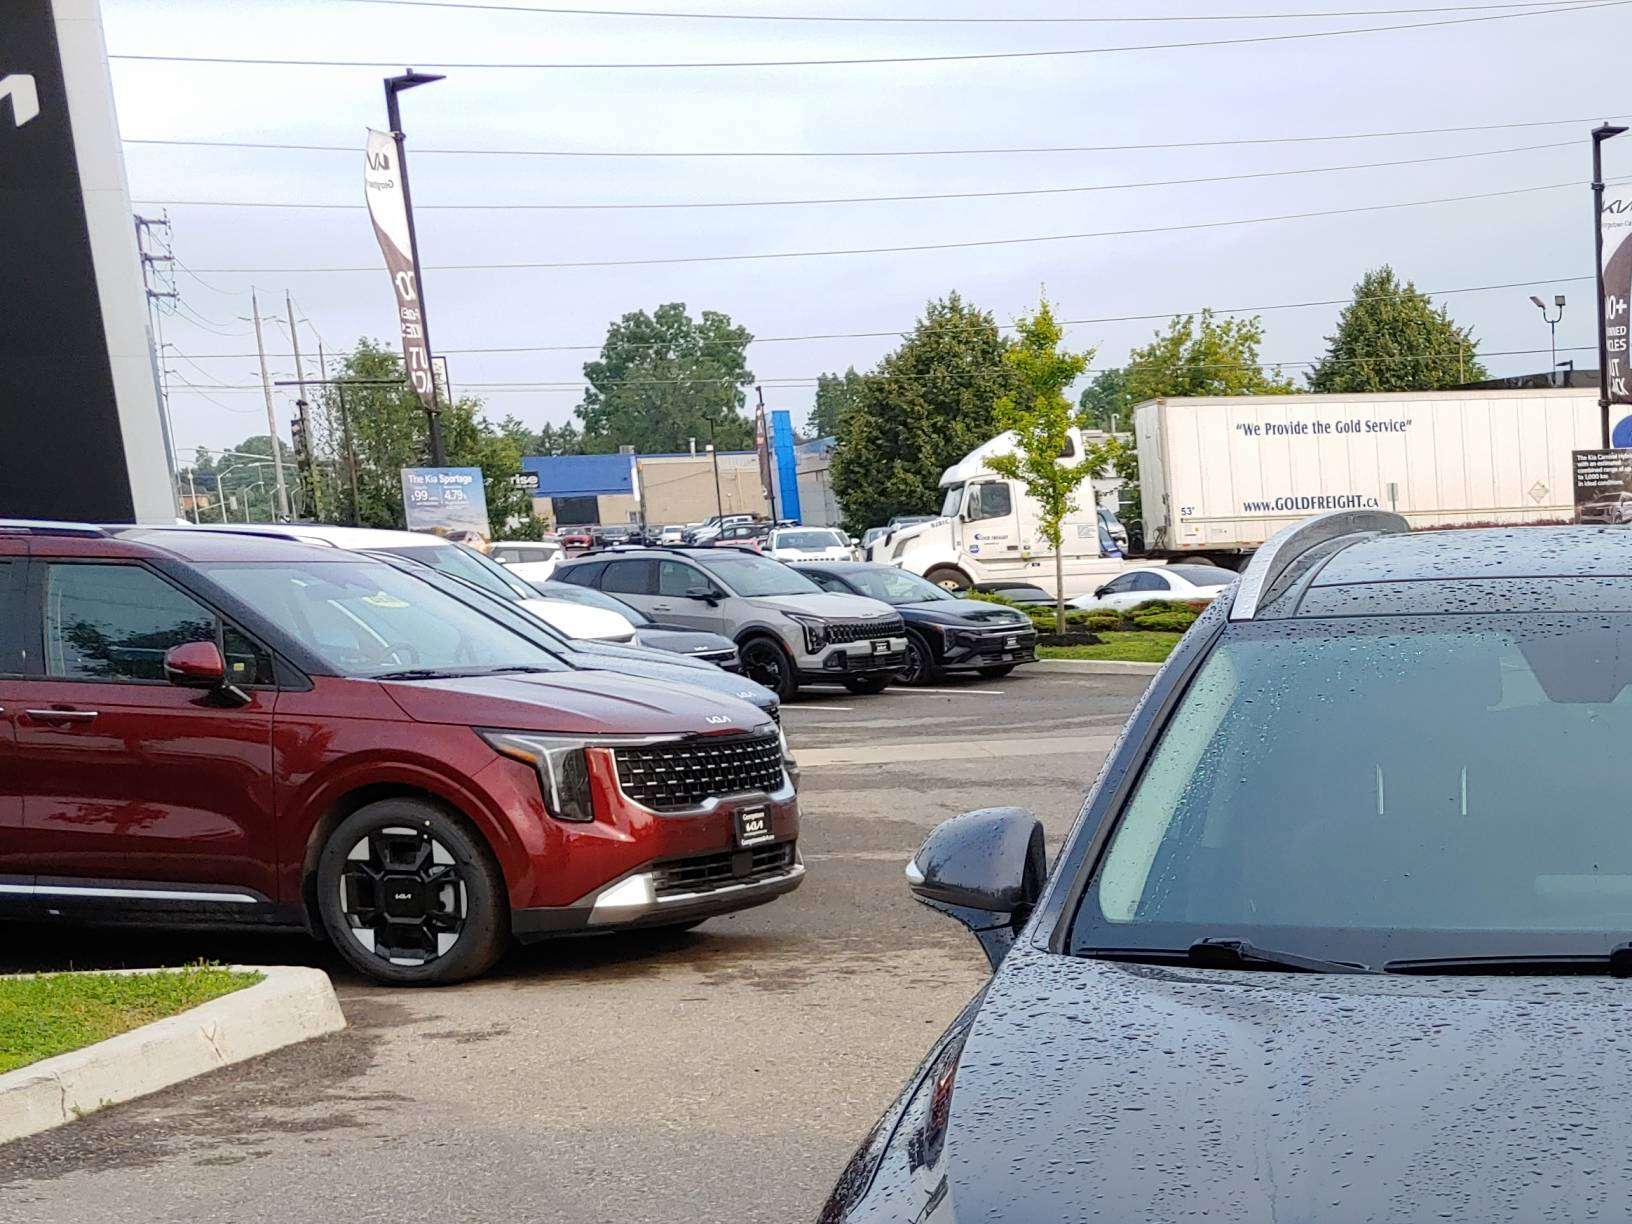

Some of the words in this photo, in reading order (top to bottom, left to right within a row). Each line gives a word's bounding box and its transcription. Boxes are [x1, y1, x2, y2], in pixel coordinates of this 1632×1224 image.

[1265, 421, 1308, 435] Provide
[1312, 421, 1331, 434] the
[1335, 419, 1361, 434] Gold
[408, 474, 424, 484] The
[425, 474, 438, 484] Kia
[439, 474, 473, 485] Sportage
[511, 473, 538, 485] rise
